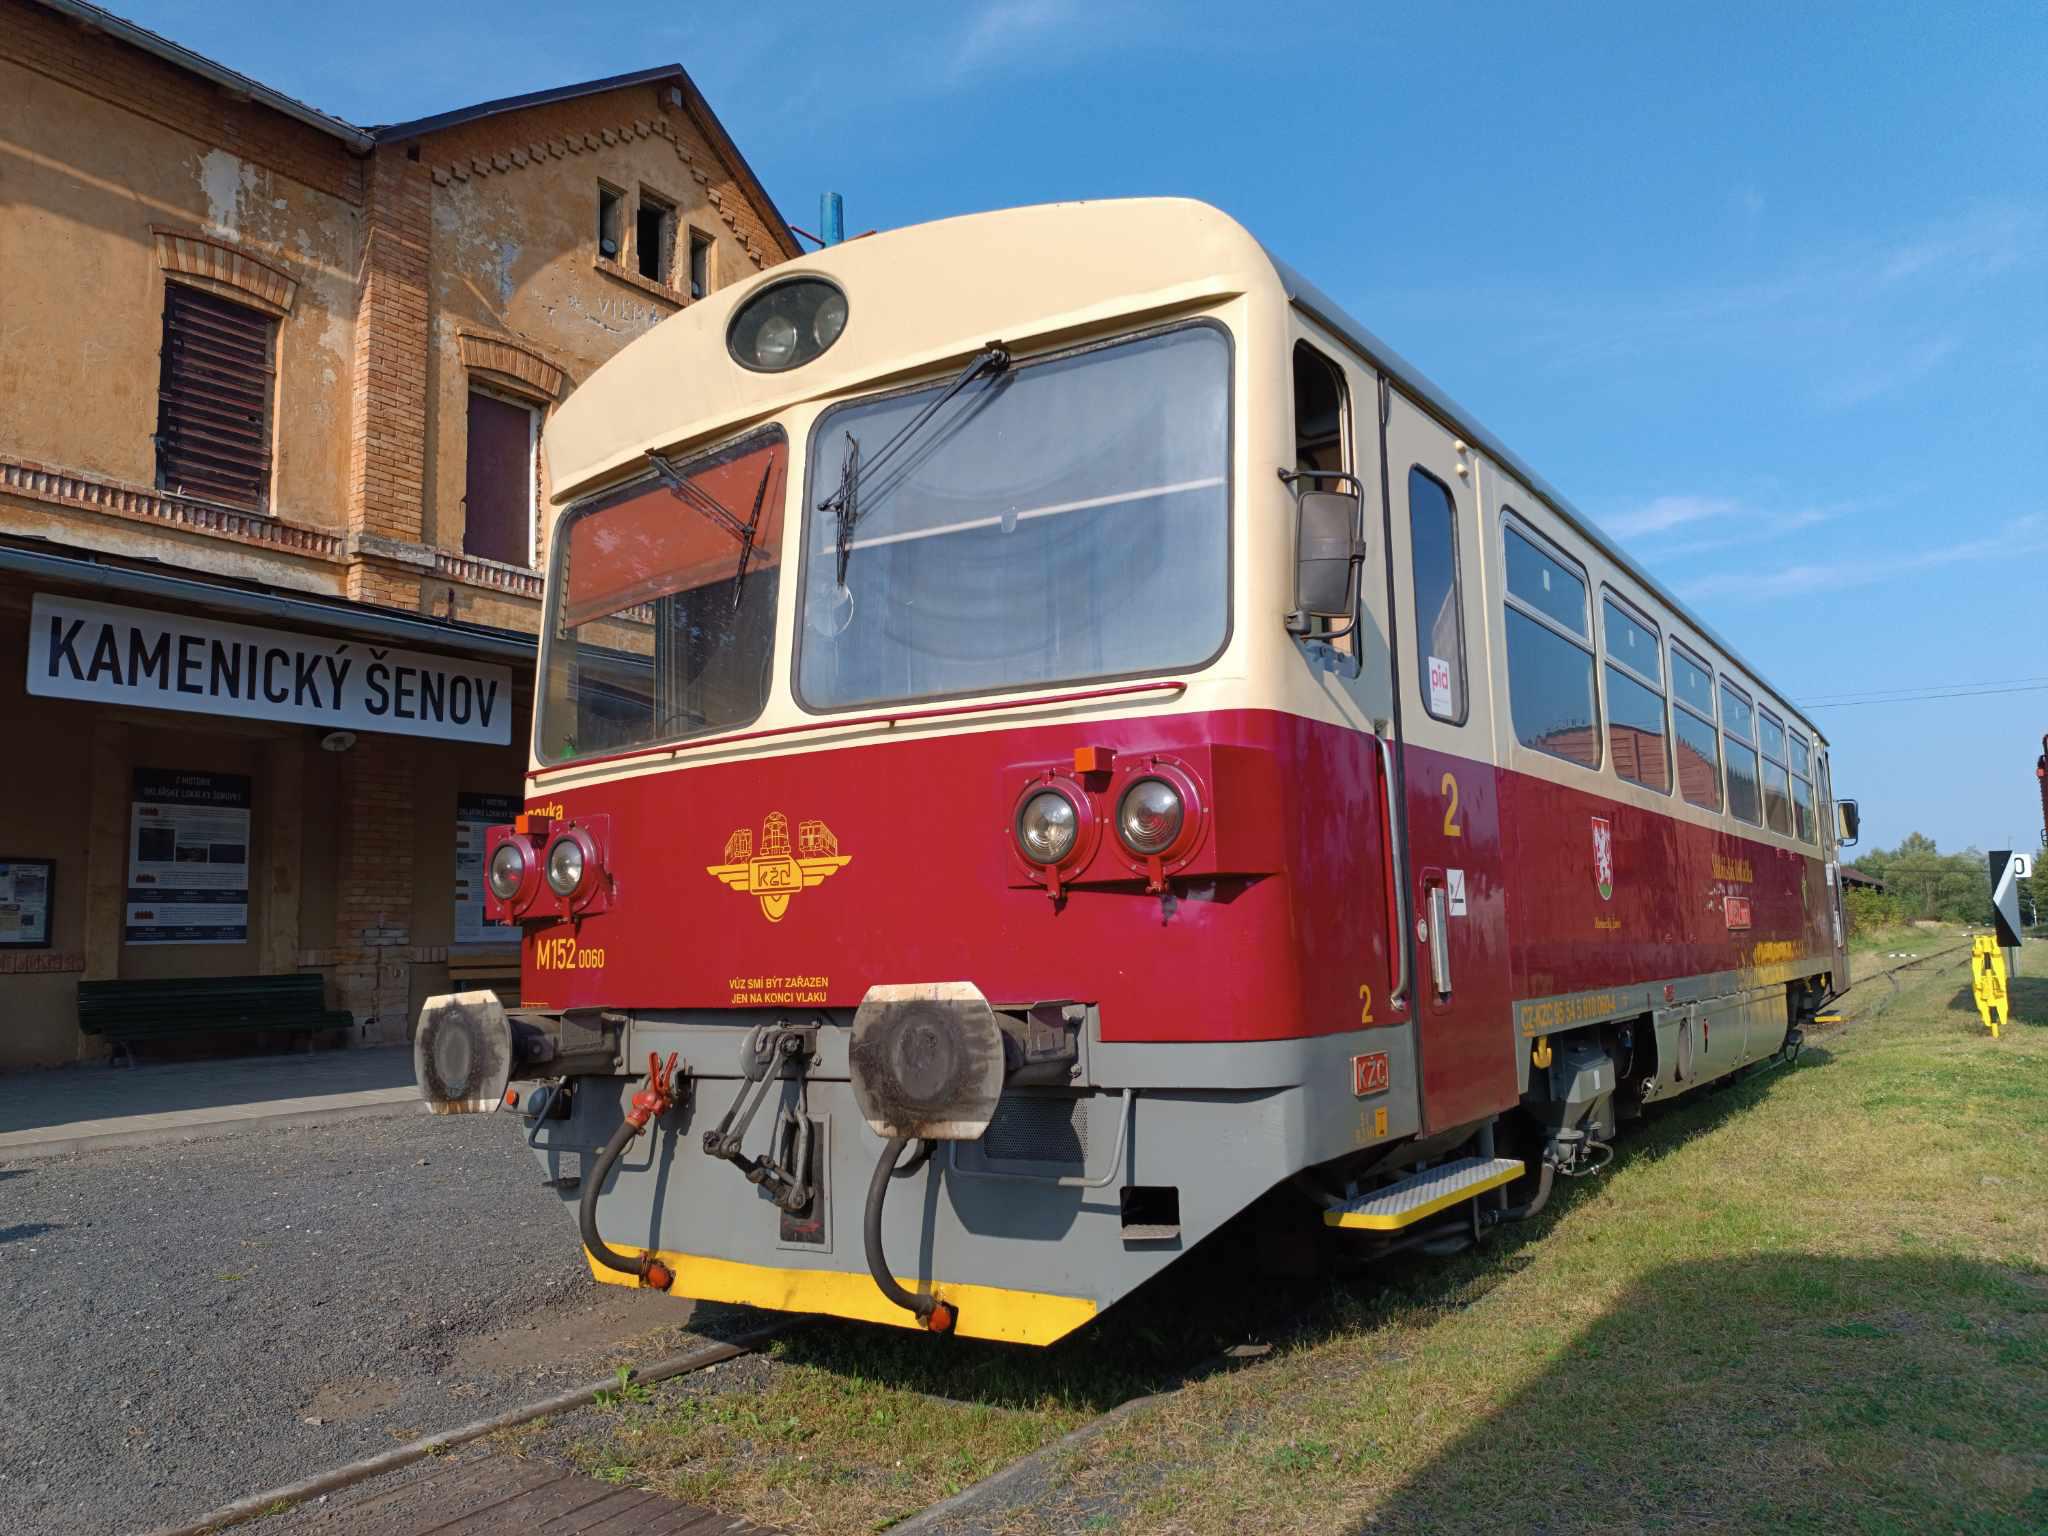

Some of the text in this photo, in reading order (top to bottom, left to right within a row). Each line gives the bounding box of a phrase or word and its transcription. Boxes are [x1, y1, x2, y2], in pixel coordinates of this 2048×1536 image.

[48, 615, 498, 727] KAMENICKÝ ŠENOV
[1431, 664, 1449, 692] pid
[1441, 772, 1461, 837] 2
[536, 938, 605, 970] M152 0060
[731, 991, 827, 1004] JEN NA KONCI VLAKU
[747, 976, 764, 989] SMÍ
[766, 976, 783, 989] BÝT
[784, 976, 829, 988] ZAŘAZEN
[1359, 984, 1374, 1024] 2
